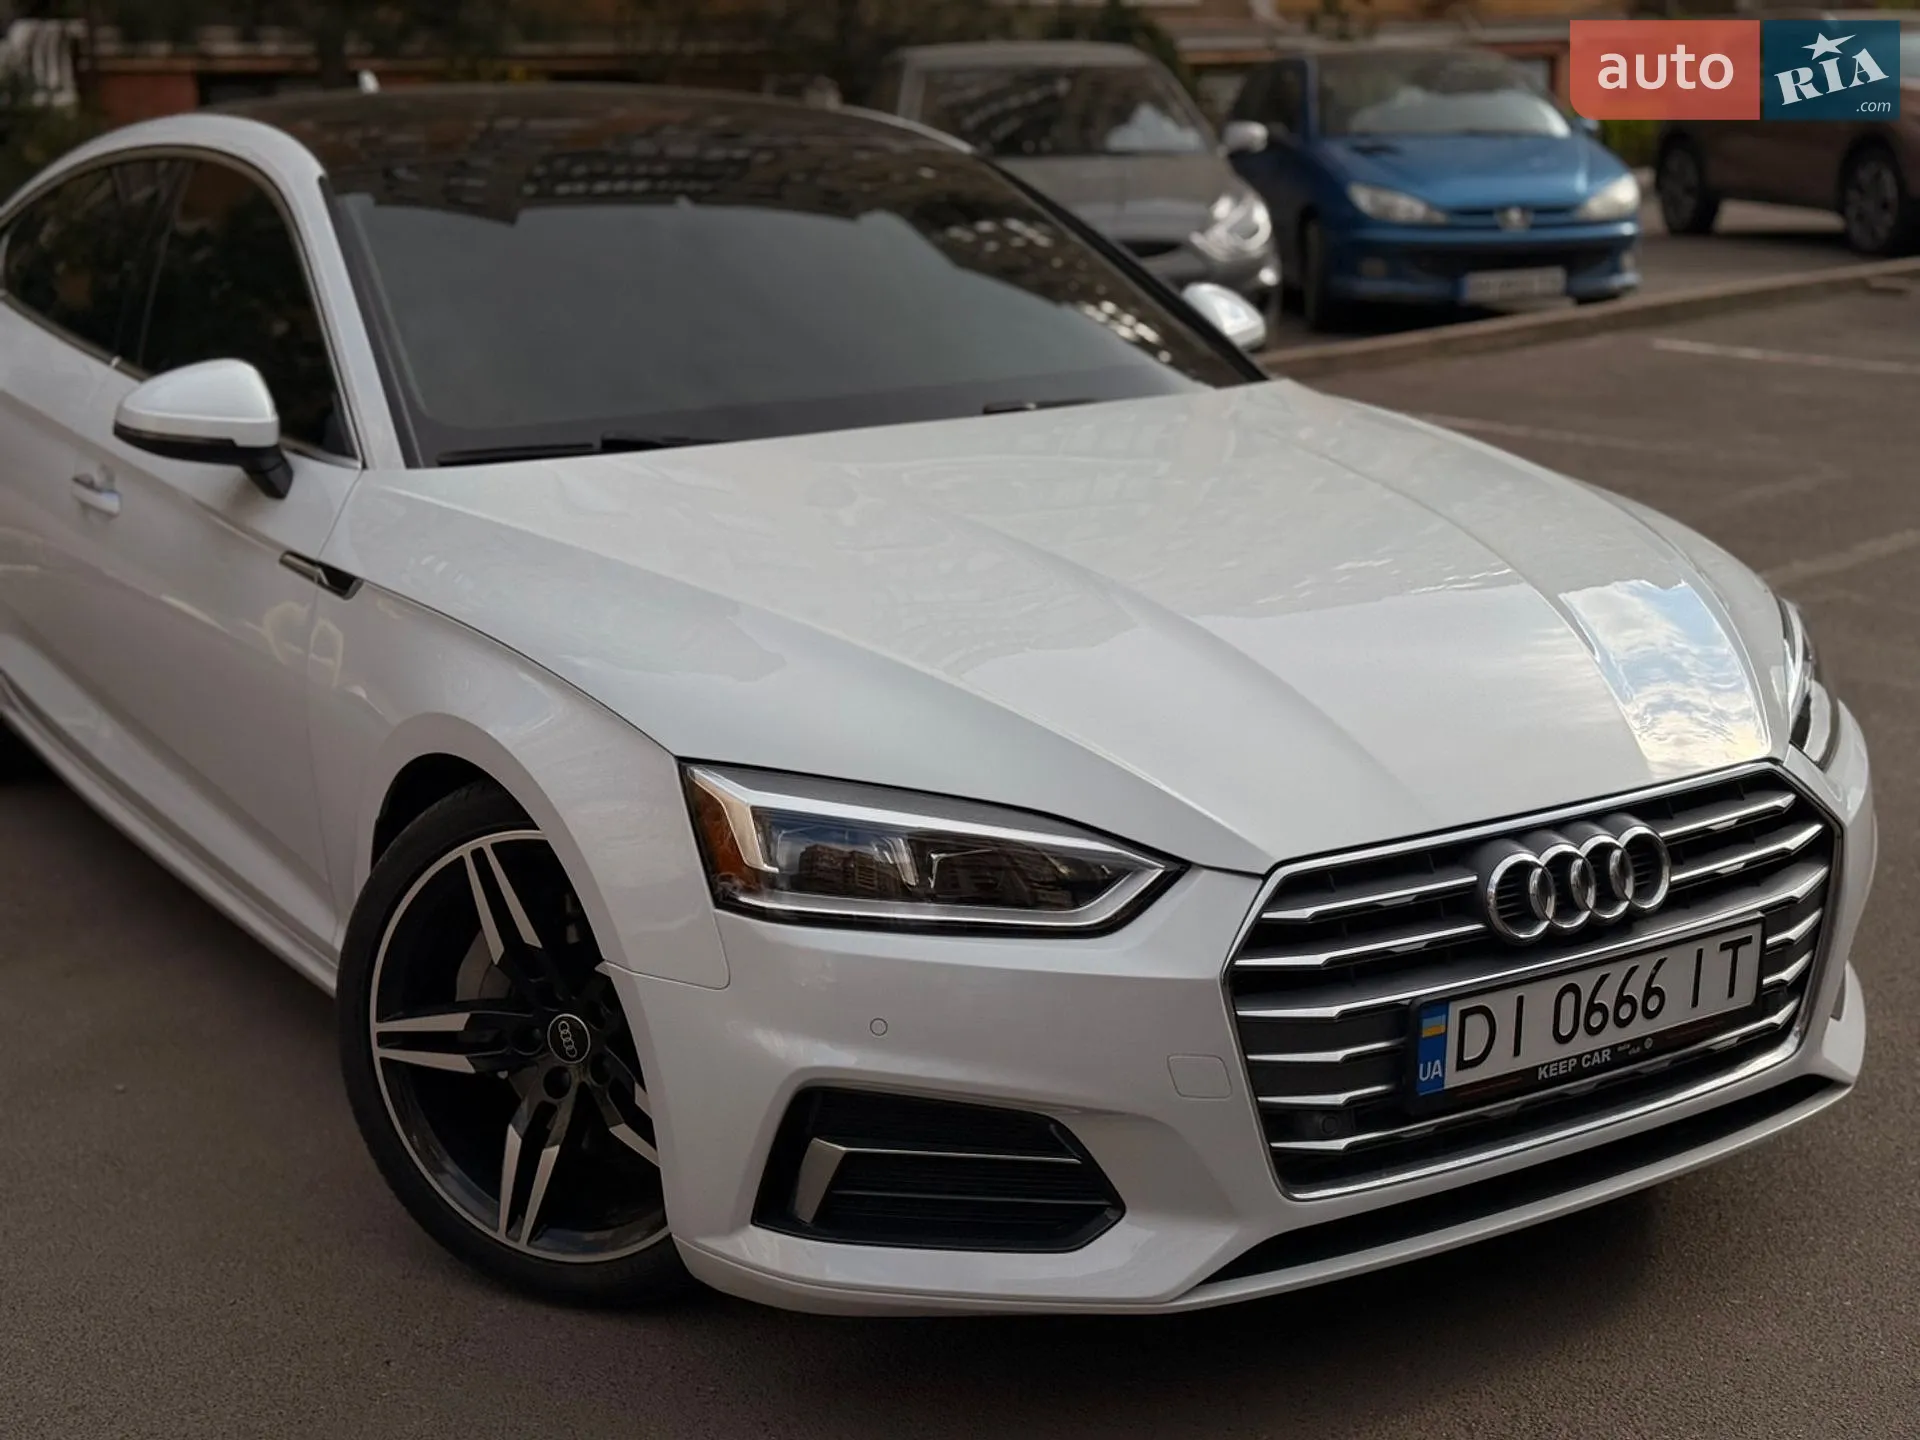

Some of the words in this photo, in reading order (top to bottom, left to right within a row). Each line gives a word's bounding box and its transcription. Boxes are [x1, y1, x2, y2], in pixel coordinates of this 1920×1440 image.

[1455, 995, 1524, 1072] DI
[1552, 957, 1668, 1044] 0666
[1690, 935, 1753, 1009] IT
[1418, 1059, 1443, 1082] UA
[1537, 1057, 1577, 1081] KEEP
[1581, 1047, 1612, 1068] CAR
